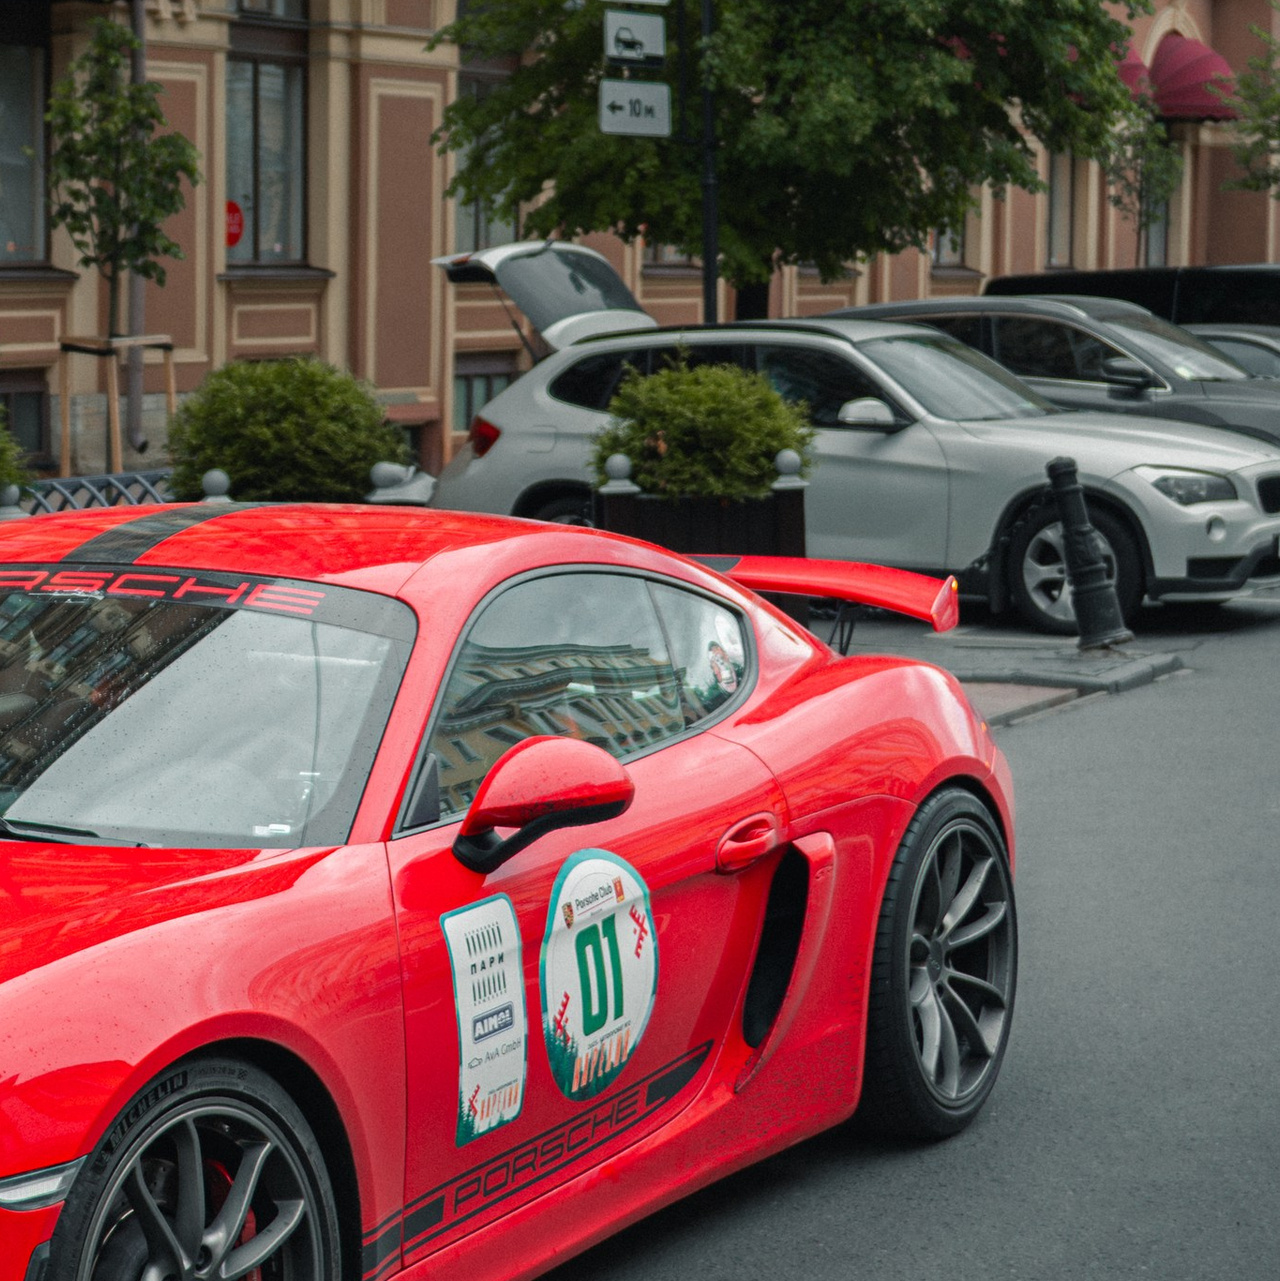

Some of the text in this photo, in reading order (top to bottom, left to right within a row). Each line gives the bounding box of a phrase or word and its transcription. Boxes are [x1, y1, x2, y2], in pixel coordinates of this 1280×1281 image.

[629, 98, 642, 118] 10
[575, 883, 613, 910] Porsche Club
[471, 952, 504, 975] ПАРИ
[575, 913, 624, 1036] 01
[501, 1036, 522, 1055] GmbH
[109, 1073, 184, 1148] MICHELIN
[454, 1089, 640, 1214] PORSCHE
